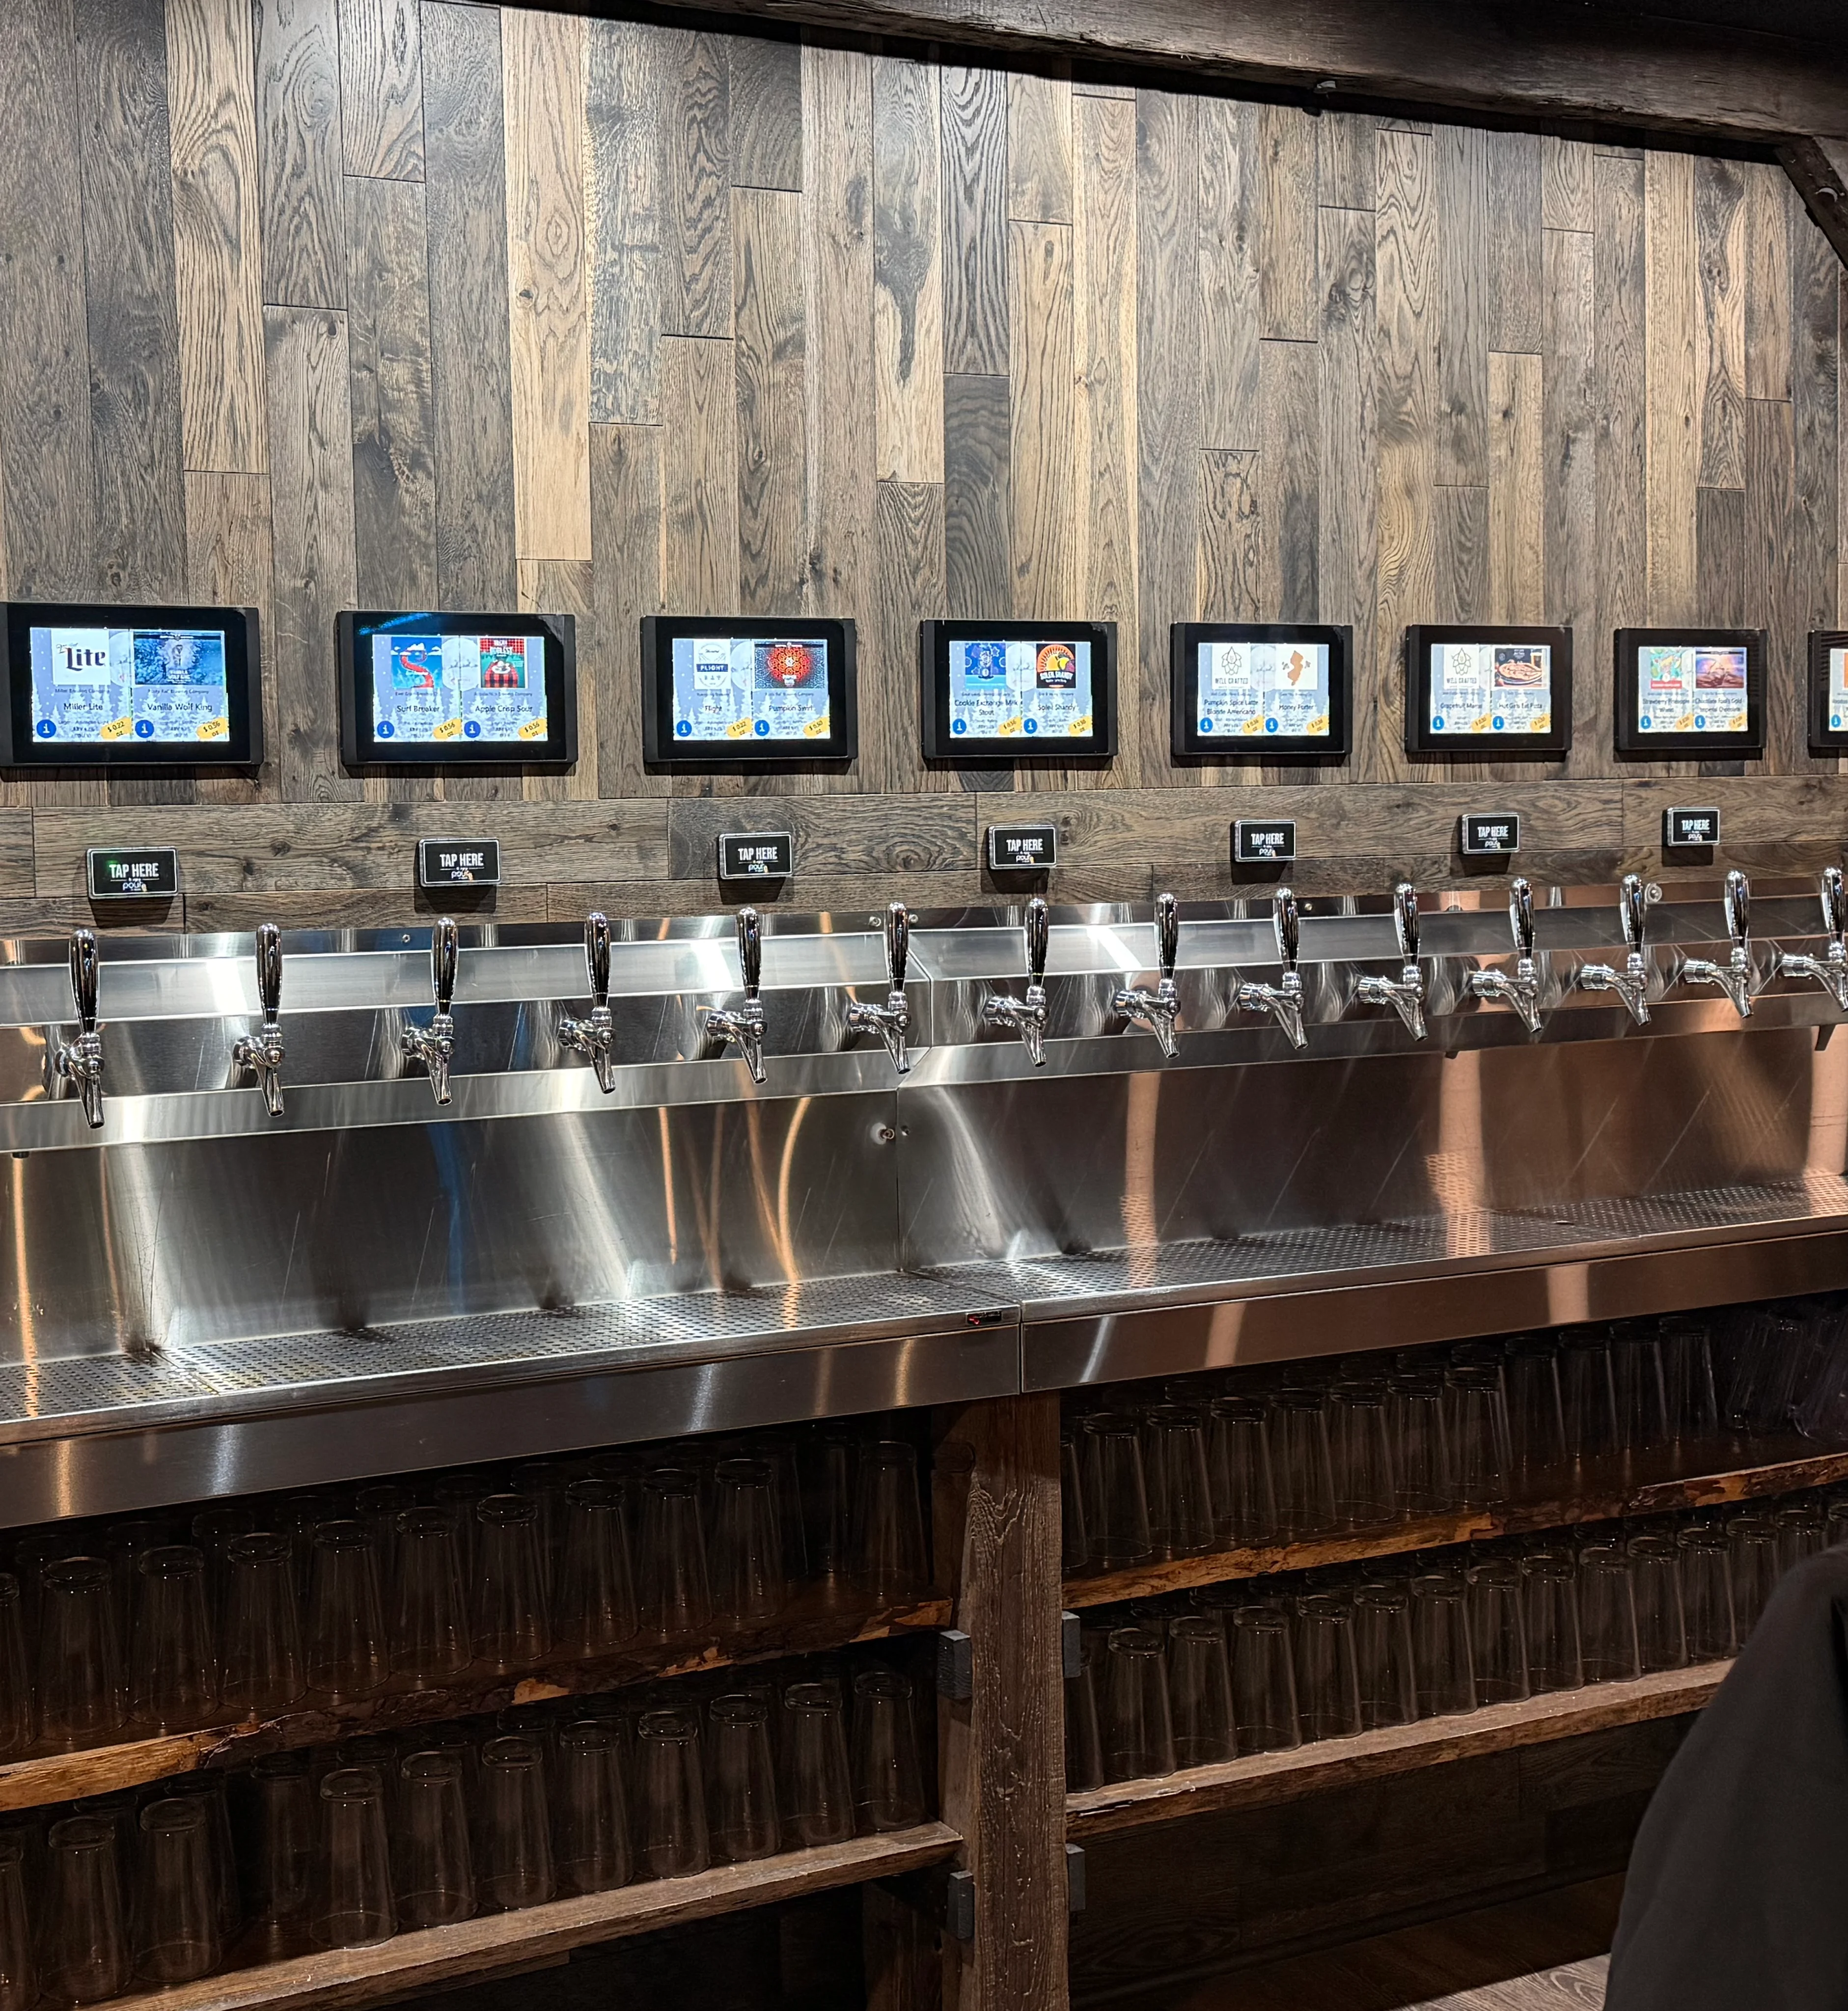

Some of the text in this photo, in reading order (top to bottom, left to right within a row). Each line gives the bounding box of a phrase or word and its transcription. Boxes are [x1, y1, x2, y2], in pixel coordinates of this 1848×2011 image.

[66, 647, 105, 671] Lite
[195, 704, 212, 712] King
[1682, 819, 1710, 830] TAP HERE
[1478, 826, 1509, 837] TAP HERE
[1006, 839, 1043, 852] TAP HERE
[1251, 833, 1284, 845] TAP HERE
[440, 853, 484, 867] TAP HERE
[738, 847, 777, 860] TAP HERE
[109, 863, 159, 878] TAP HERE
